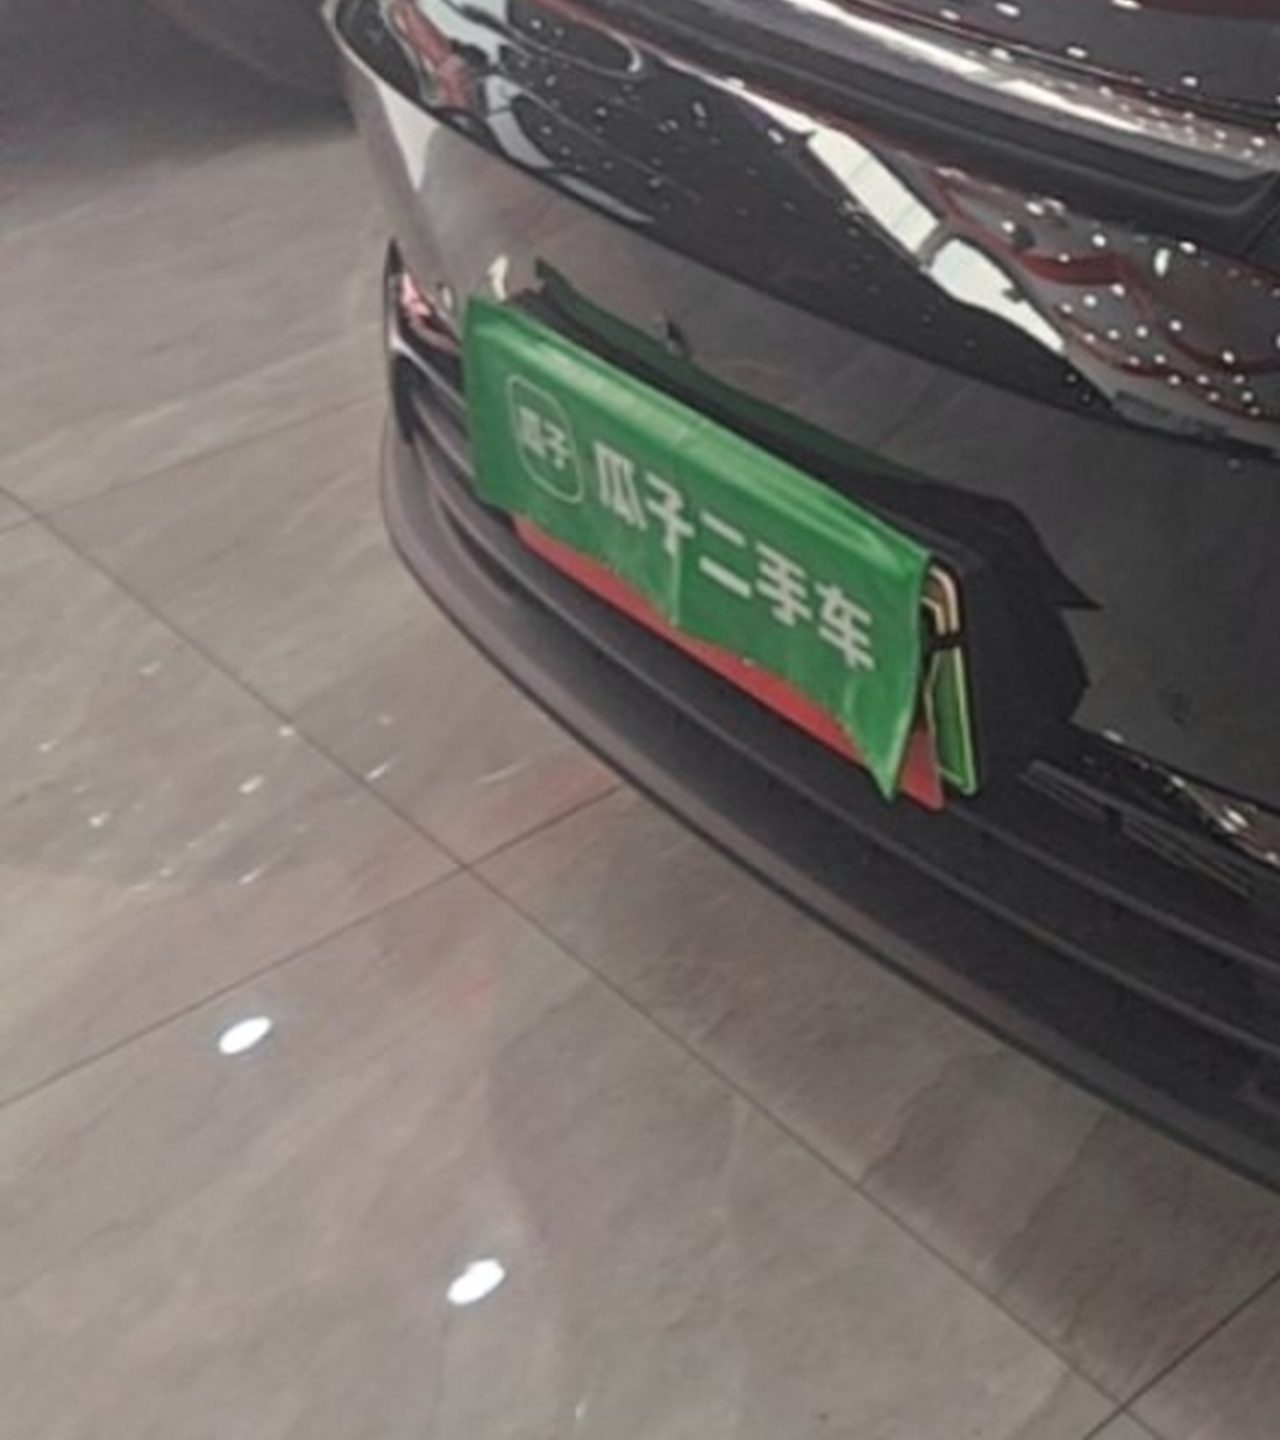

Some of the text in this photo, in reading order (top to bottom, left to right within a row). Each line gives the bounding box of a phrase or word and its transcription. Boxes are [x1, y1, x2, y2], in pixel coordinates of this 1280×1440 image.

[593, 438, 877, 672] 瓜子二手车
